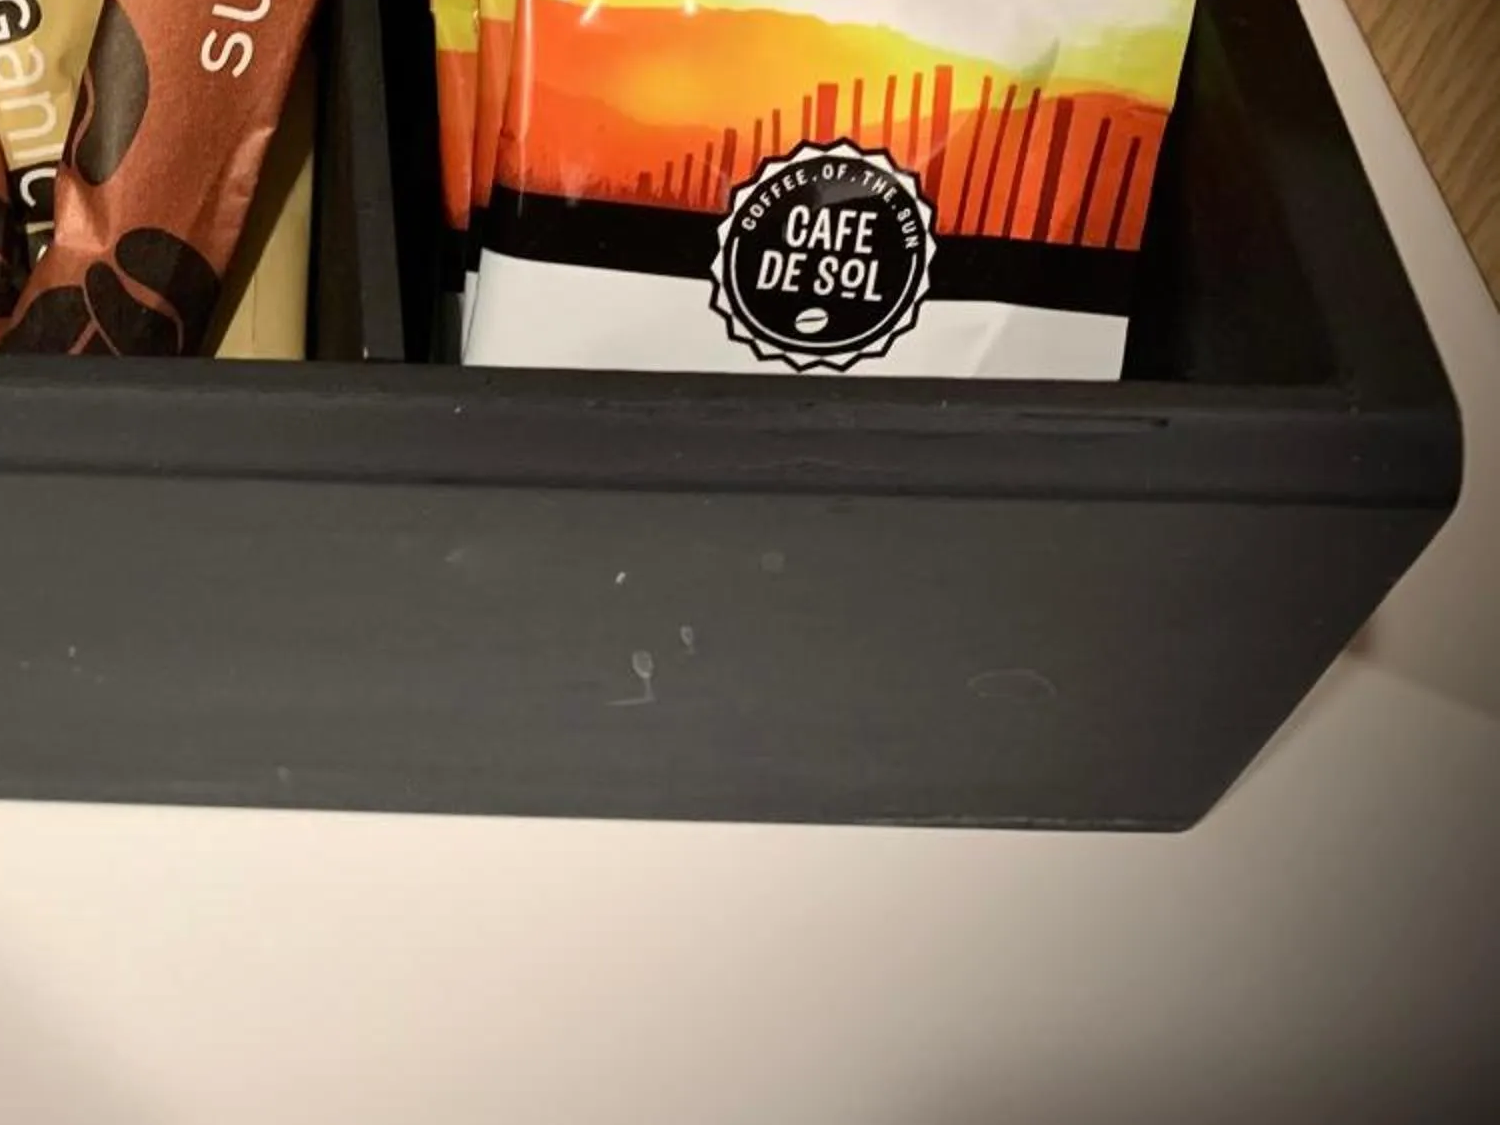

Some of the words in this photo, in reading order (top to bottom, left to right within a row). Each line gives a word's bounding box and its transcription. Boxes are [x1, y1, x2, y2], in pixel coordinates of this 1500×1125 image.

[741, 168, 807, 231] COFFEE
[822, 163, 849, 181] OF
[863, 170, 898, 203] THE
[896, 207, 920, 250] SUN
[784, 204, 878, 254] CAFE
[756, 249, 807, 293] DE
